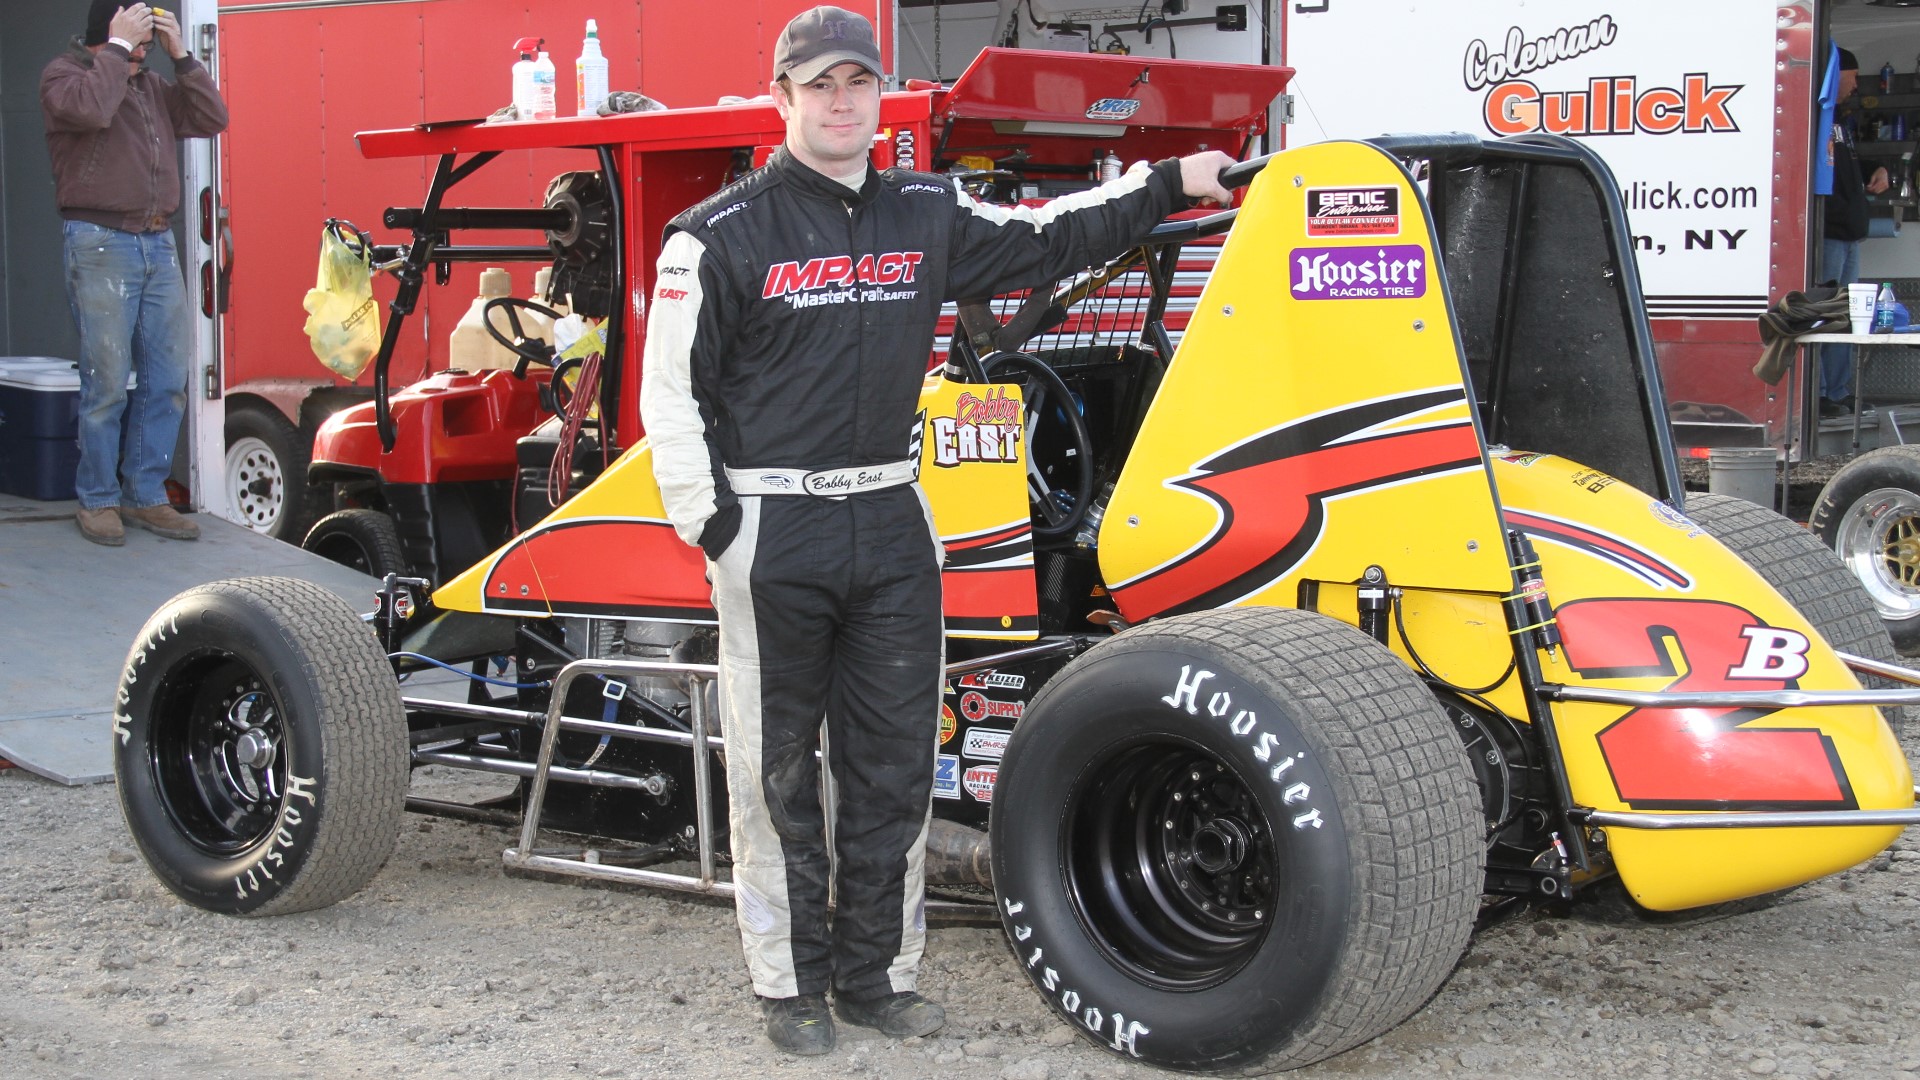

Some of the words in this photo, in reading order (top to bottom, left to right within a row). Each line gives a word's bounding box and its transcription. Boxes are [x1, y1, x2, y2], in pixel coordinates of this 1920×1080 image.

[1463, 14, 1617, 91] Coleman
[1483, 72, 1746, 138] Gulick
[901, 184, 945, 194] IMPACT
[1319, 191, 1386, 205] BENIC
[706, 201, 748, 228] IMPACT
[1684, 229, 1748, 250] NY
[762, 252, 923, 299] IMPACT
[1292, 249, 1422, 292] Hoosier
[659, 288, 688, 301] EAST
[784, 294, 793, 303] by
[883, 291, 918, 301] SAFETY
[1329, 288, 1379, 297] RACING
[1383, 287, 1415, 296] TIRE
[956, 386, 1021, 433] Bobby
[930, 416, 1022, 468] EAST
[811, 474, 852, 490] Bobby
[857, 471, 883, 486] East
[988, 675, 1024, 684] KEIZER
[987, 701, 1023, 718] SUPPLY
[1161, 664, 1325, 830] Hoosier
[1005, 897, 1150, 1058] Hoosier
